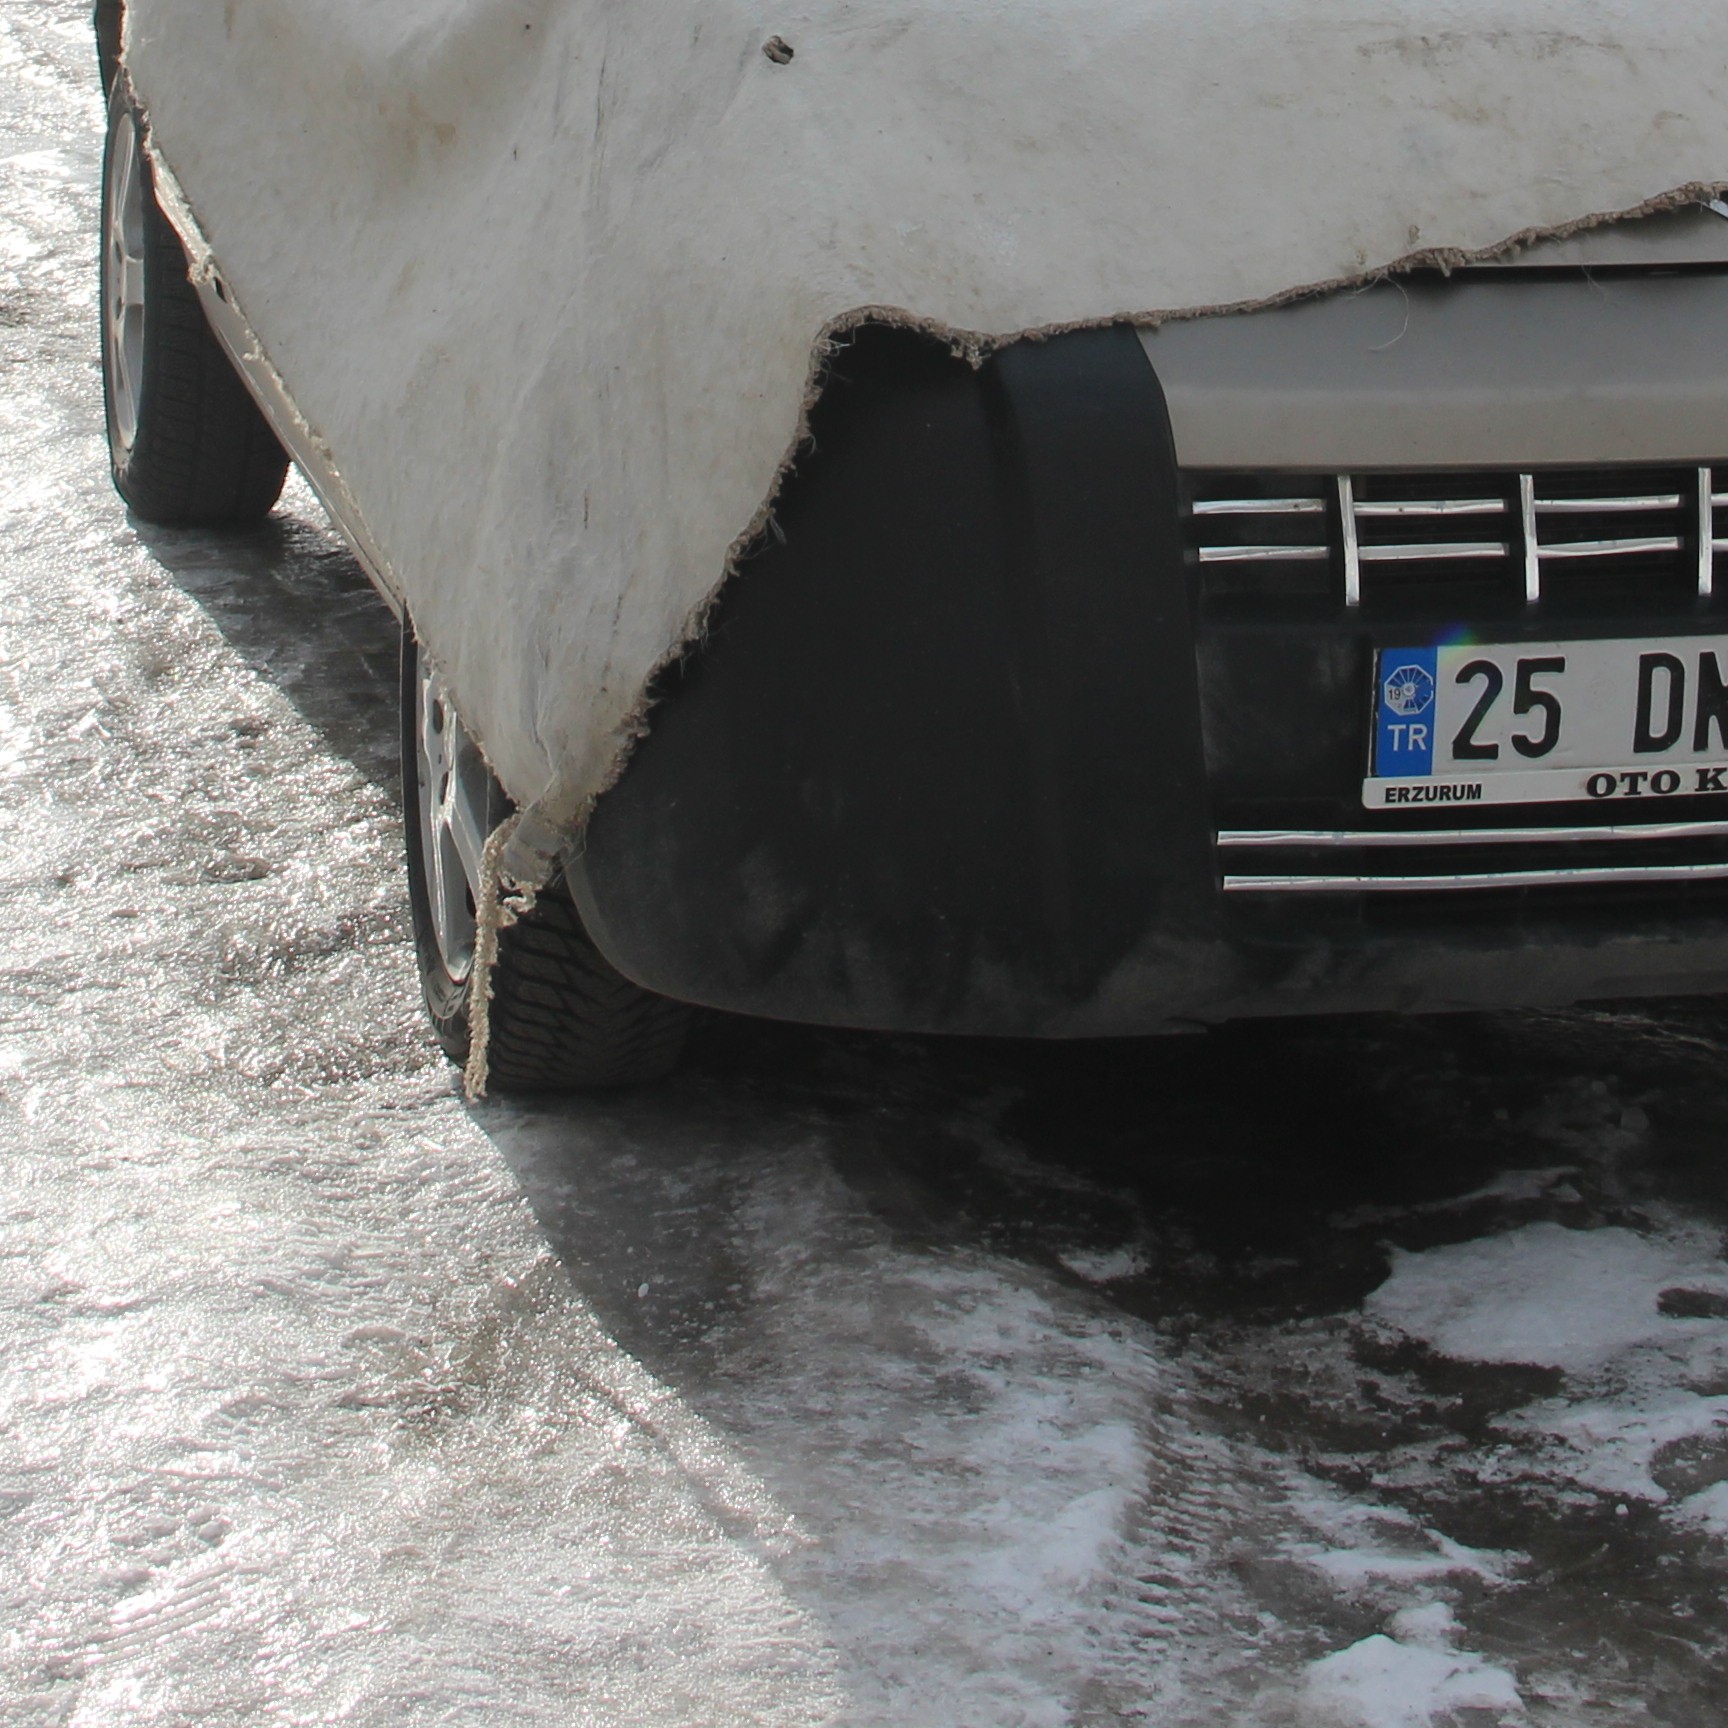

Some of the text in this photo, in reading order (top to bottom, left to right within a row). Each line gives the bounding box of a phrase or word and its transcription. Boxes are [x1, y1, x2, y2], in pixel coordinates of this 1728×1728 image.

[1452, 656, 1565, 761] 25
[1387, 724, 1428, 752] TR
[1385, 783, 1482, 803] ERZURUM
[1586, 769, 1681, 798] OTO
